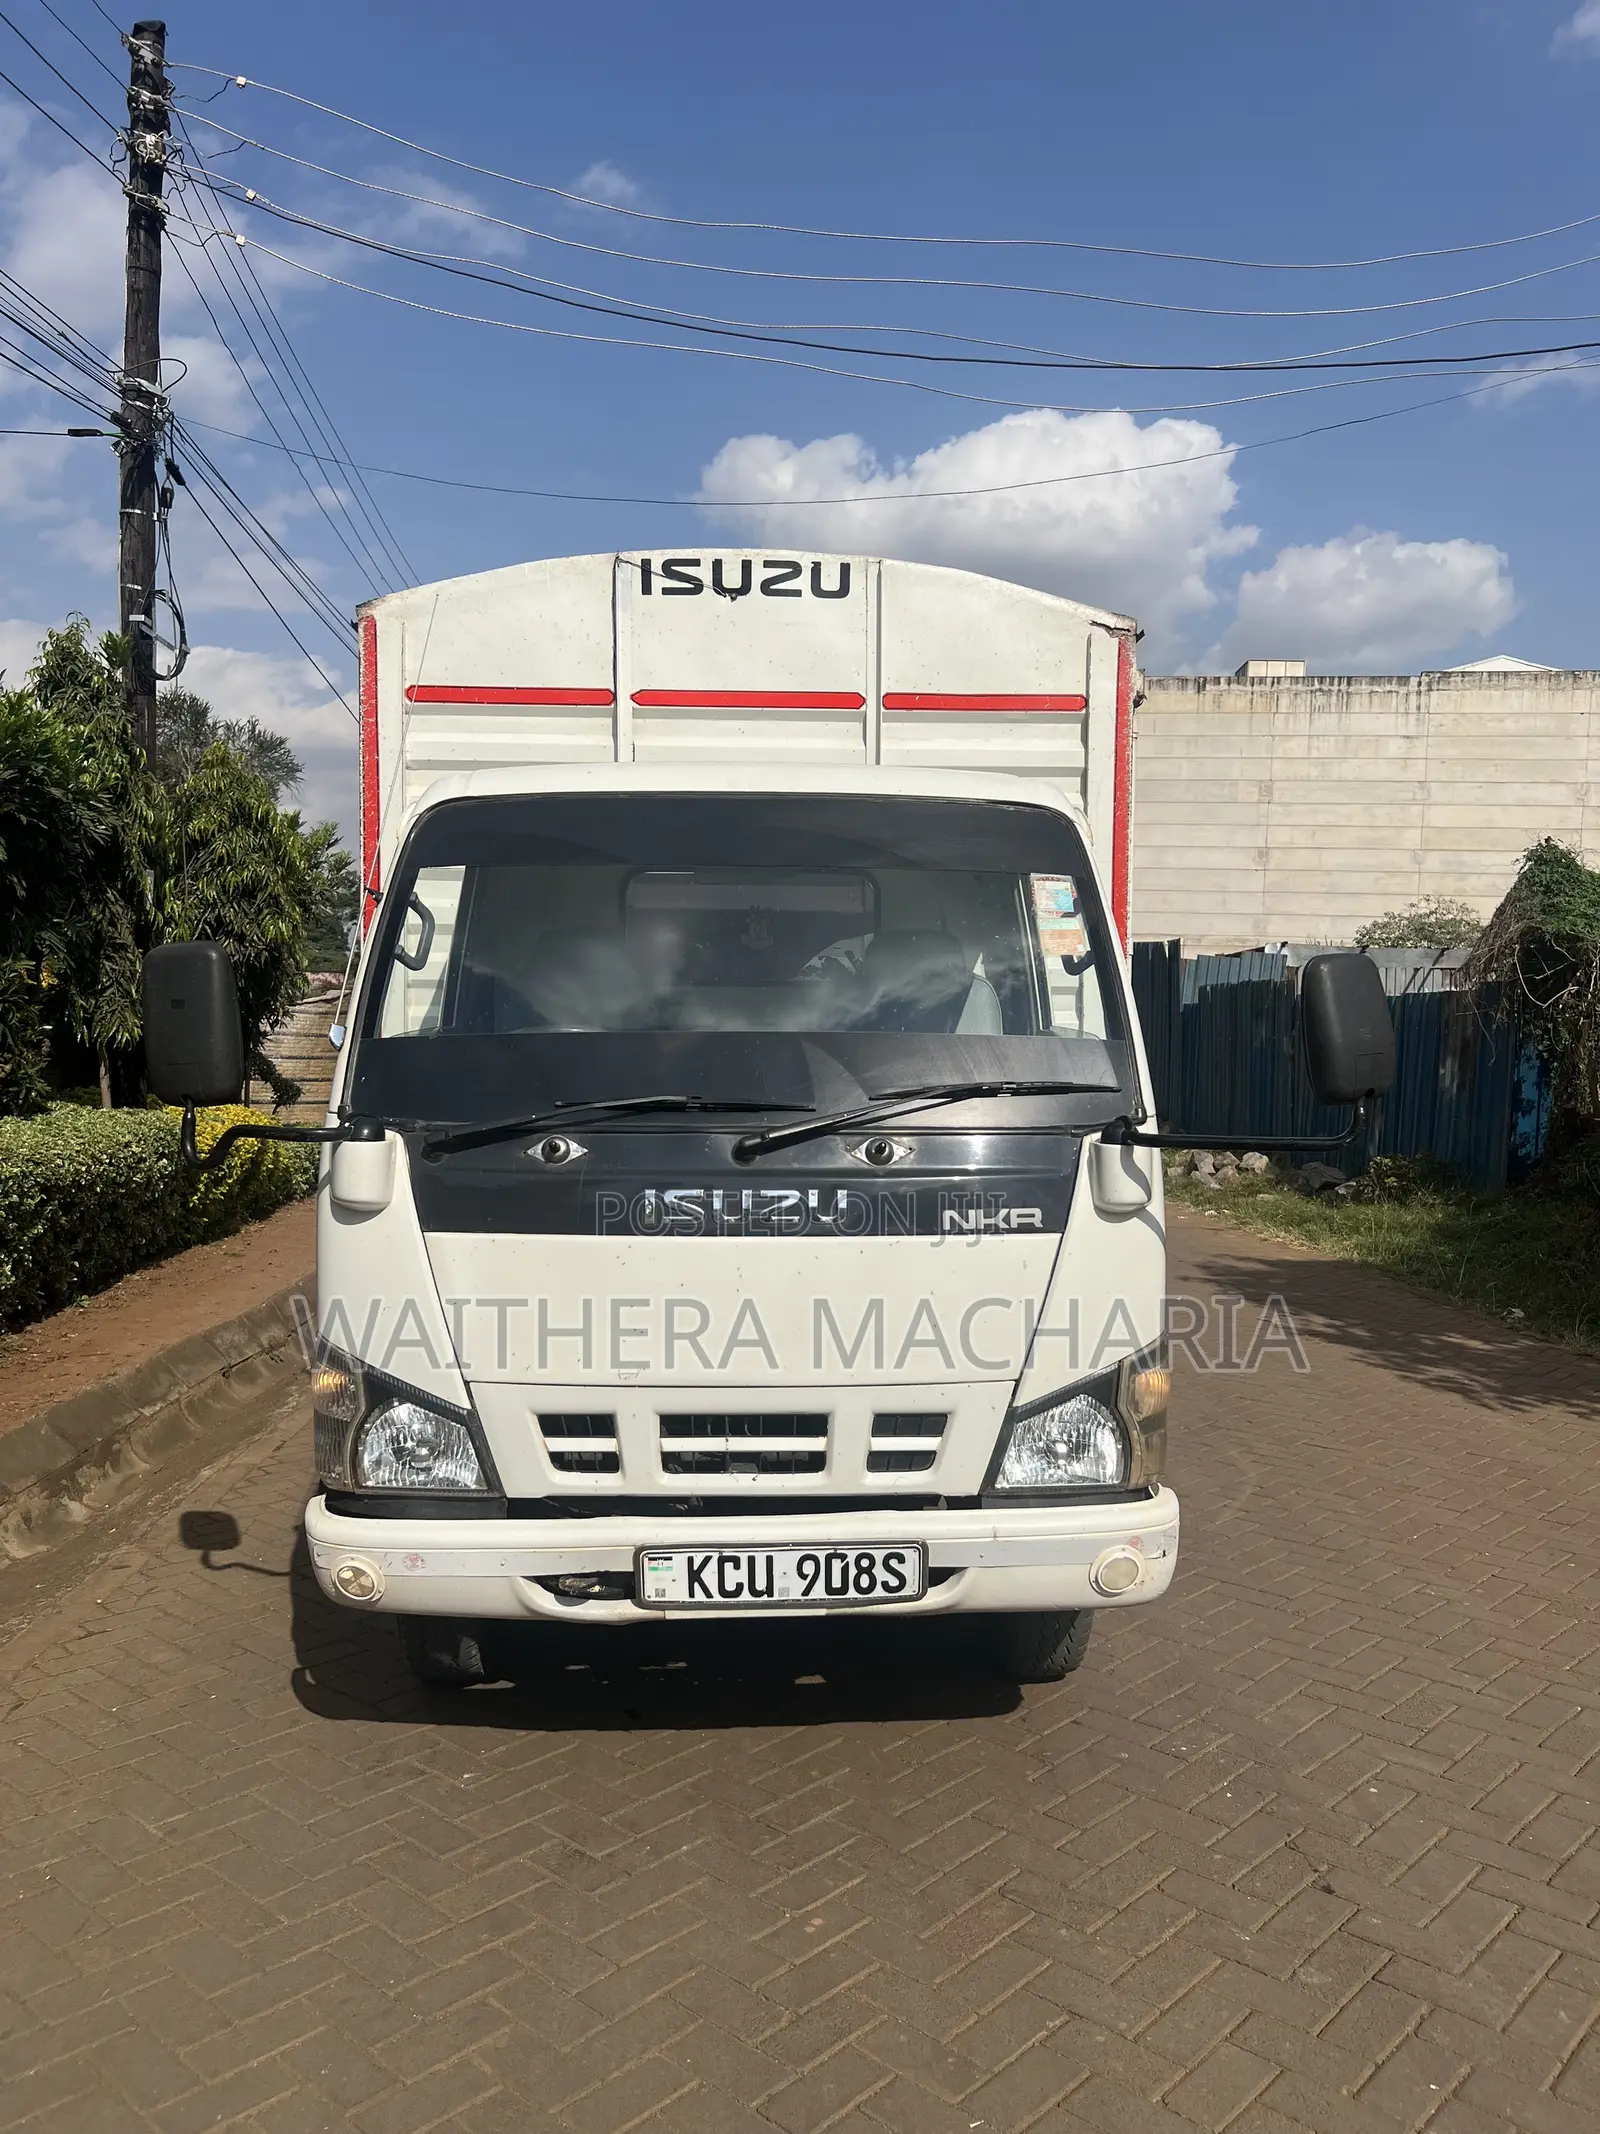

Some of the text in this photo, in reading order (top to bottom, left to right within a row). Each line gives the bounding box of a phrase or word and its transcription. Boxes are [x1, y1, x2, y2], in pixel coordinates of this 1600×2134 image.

[640, 558, 851, 599] ISUZU
[644, 1188, 848, 1225] ISUZU
[942, 1207, 1044, 1230] NKR
[687, 1554, 774, 1599] KCU
[796, 1551, 907, 1597] 908S
